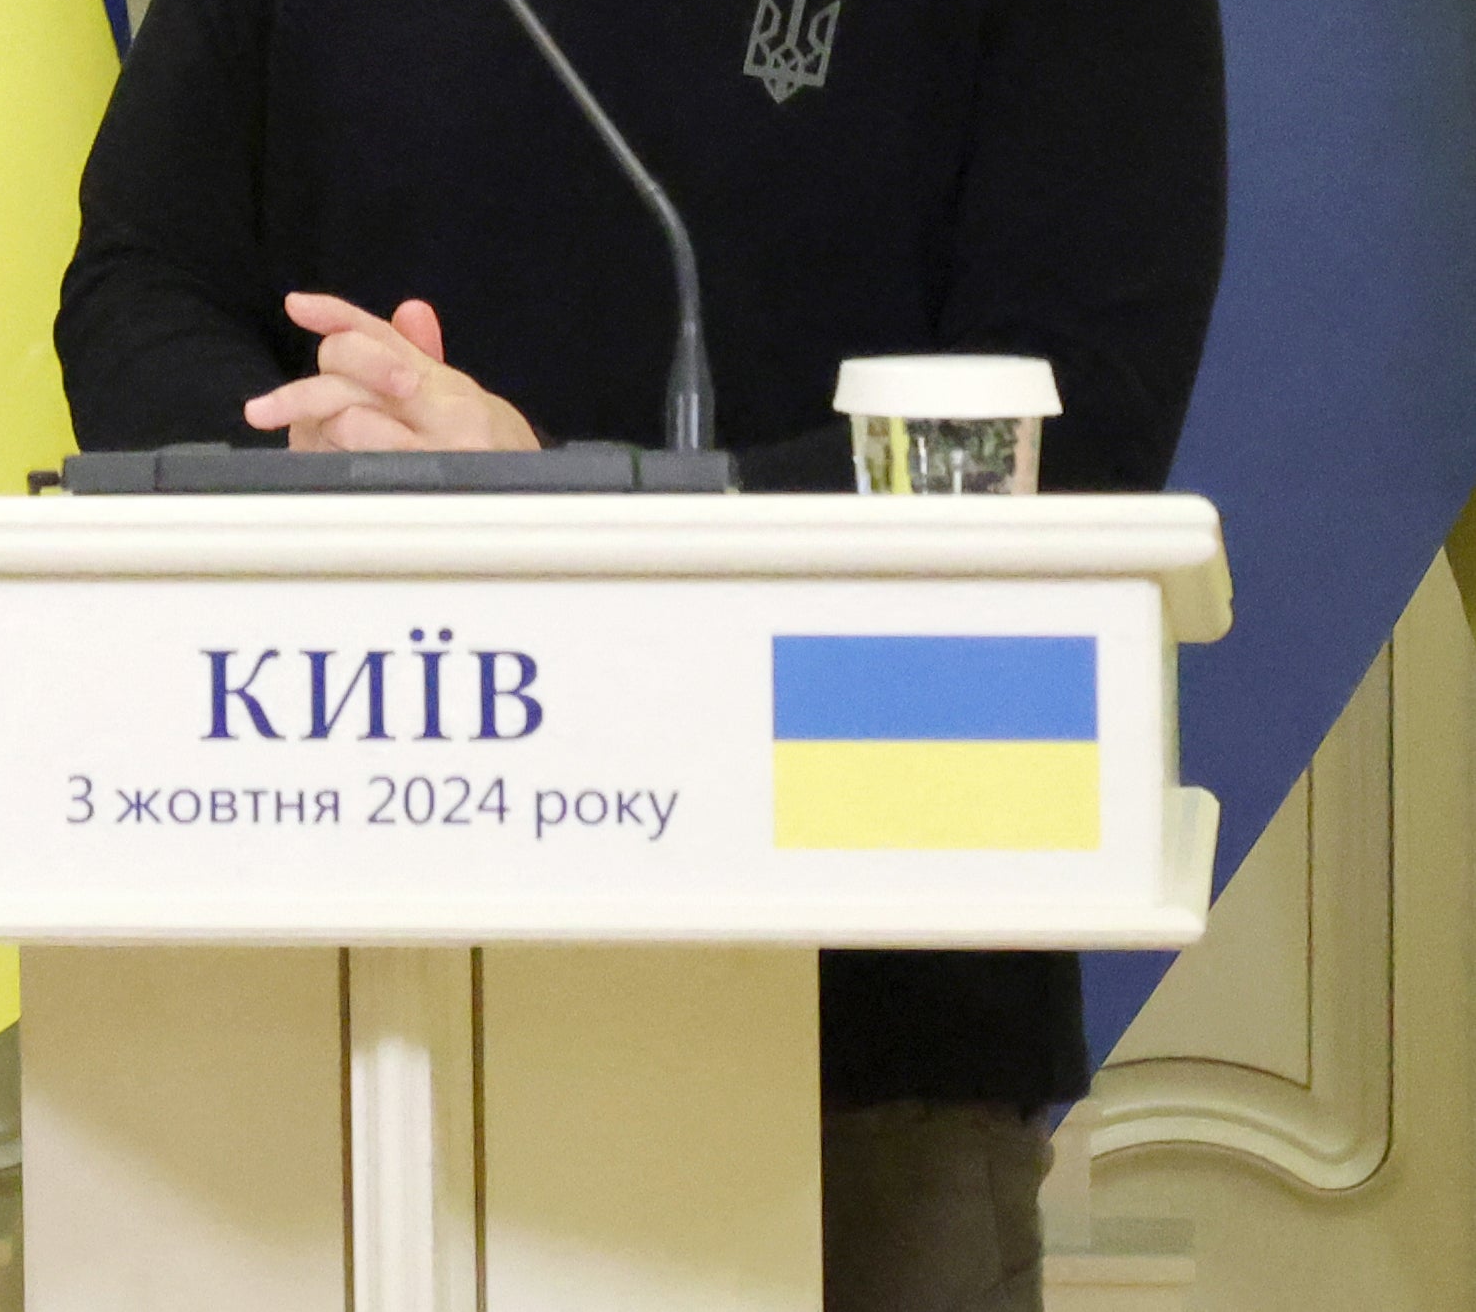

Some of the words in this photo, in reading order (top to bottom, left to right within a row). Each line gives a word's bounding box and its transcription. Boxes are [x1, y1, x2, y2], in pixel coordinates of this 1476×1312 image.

[201, 627, 545, 740] КИЇВ
[68, 775, 95, 824] 3
[116, 788, 341, 824] жовтня
[367, 776, 510, 825] 2024
[535, 790, 680, 841] року
